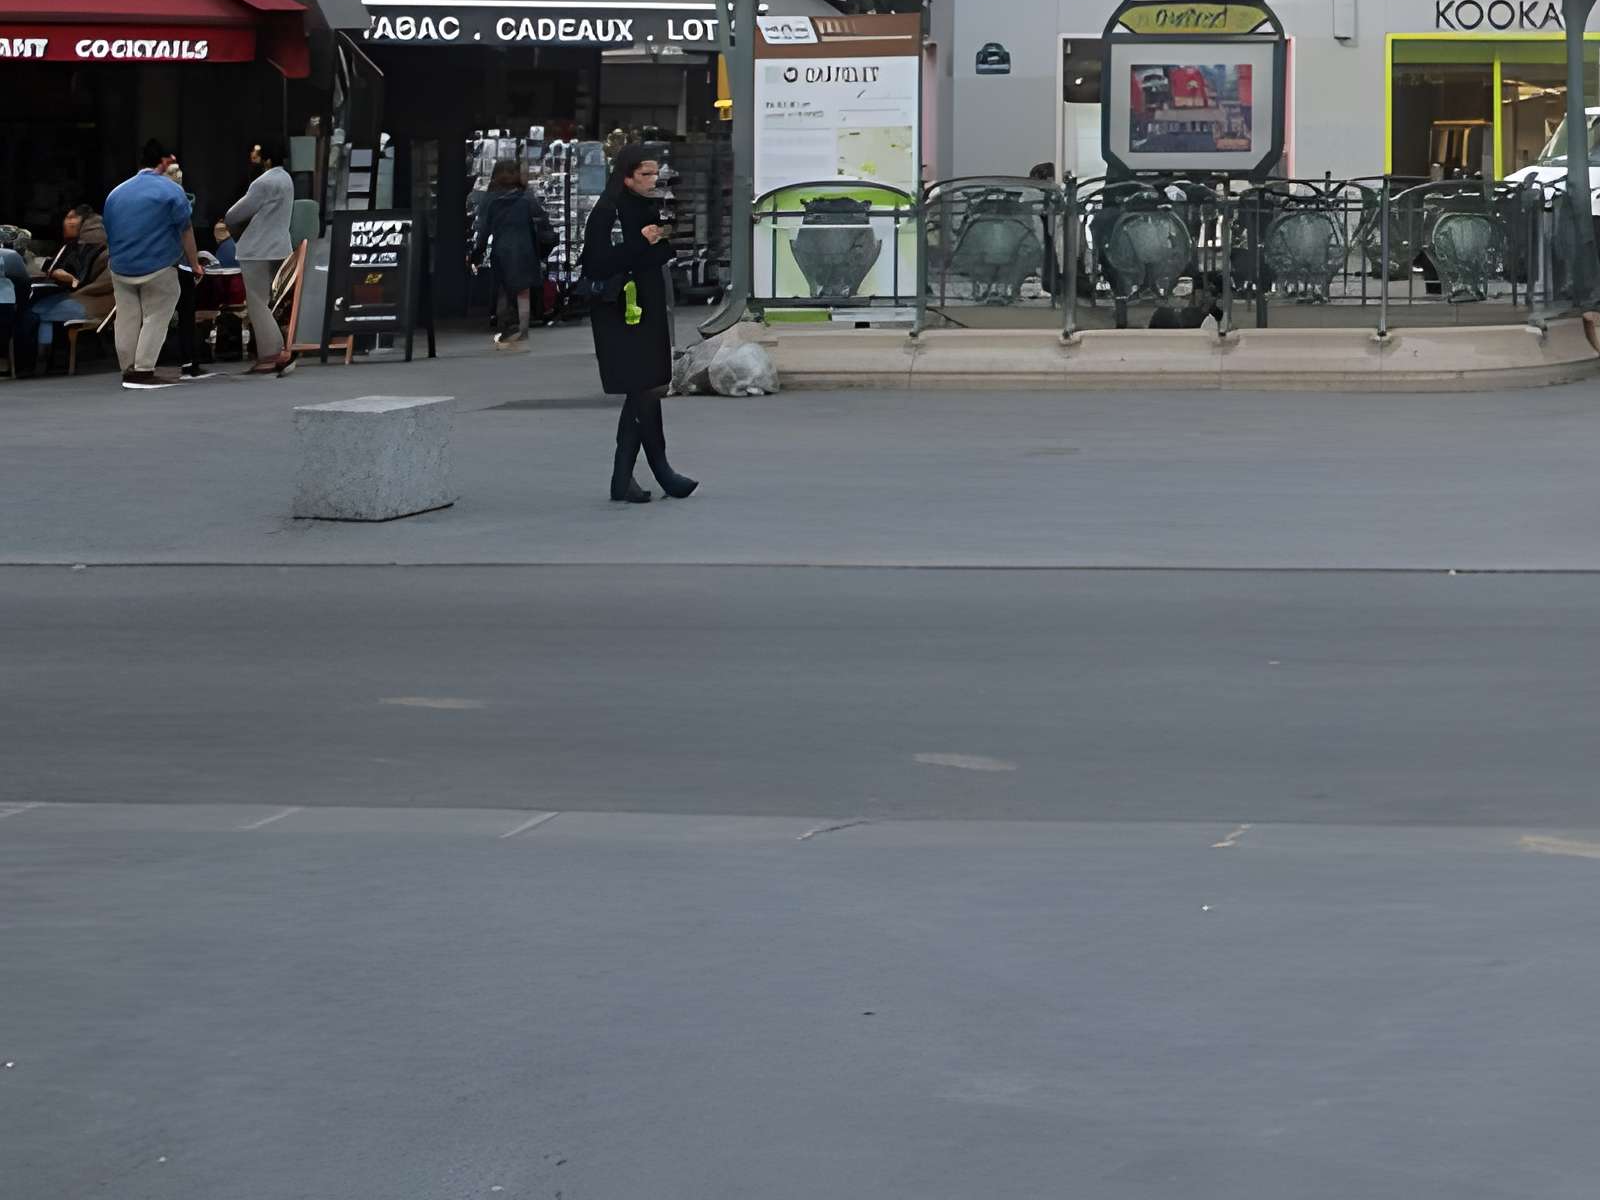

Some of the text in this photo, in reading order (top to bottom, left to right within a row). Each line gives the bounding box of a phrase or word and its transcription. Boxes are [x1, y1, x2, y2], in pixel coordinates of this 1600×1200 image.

[496, 17, 633, 41] CADEAUX
[667, 19, 736, 41] LOT
[75, 39, 208, 59] COCKTAILS
